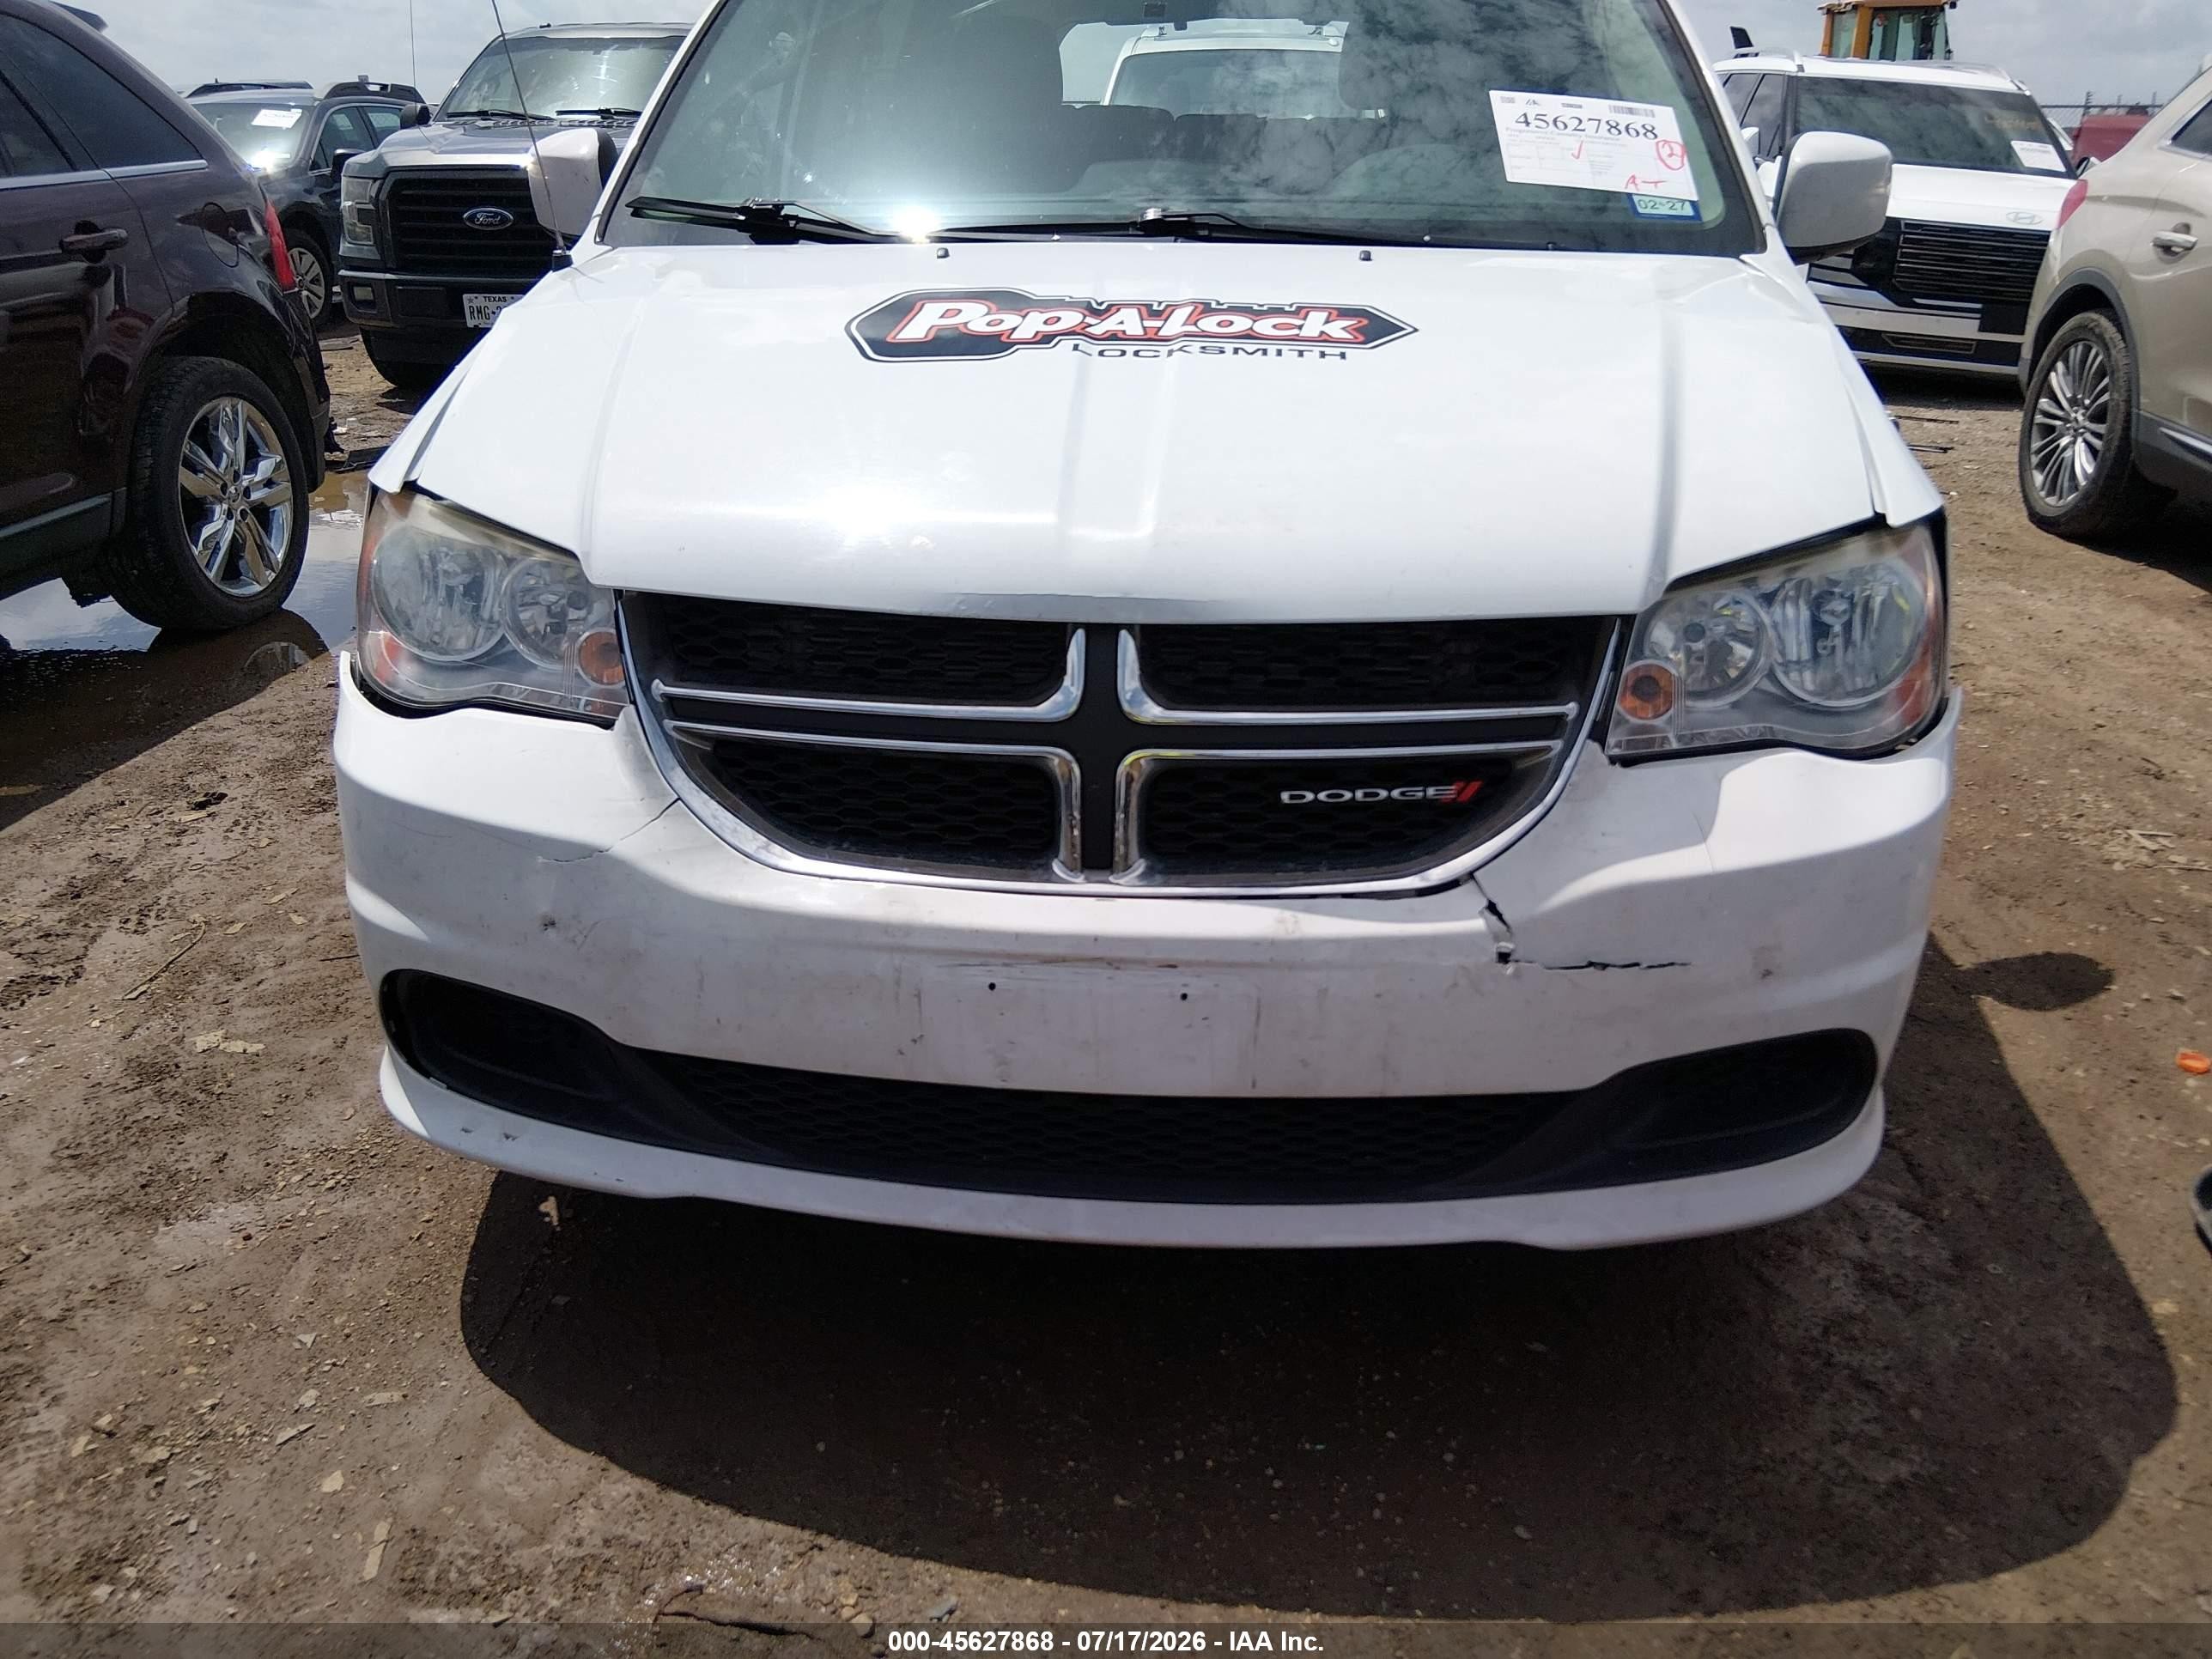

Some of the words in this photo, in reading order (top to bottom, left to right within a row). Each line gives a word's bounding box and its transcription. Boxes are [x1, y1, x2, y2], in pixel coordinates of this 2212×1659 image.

[1515, 112, 1659, 141] 45627868
[475, 212, 501, 225] Ford
[890, 300, 1365, 343] Pop-A-Lock
[1072, 343, 1347, 360] LOCKSMITH
[1280, 785, 1458, 804] DODGE
